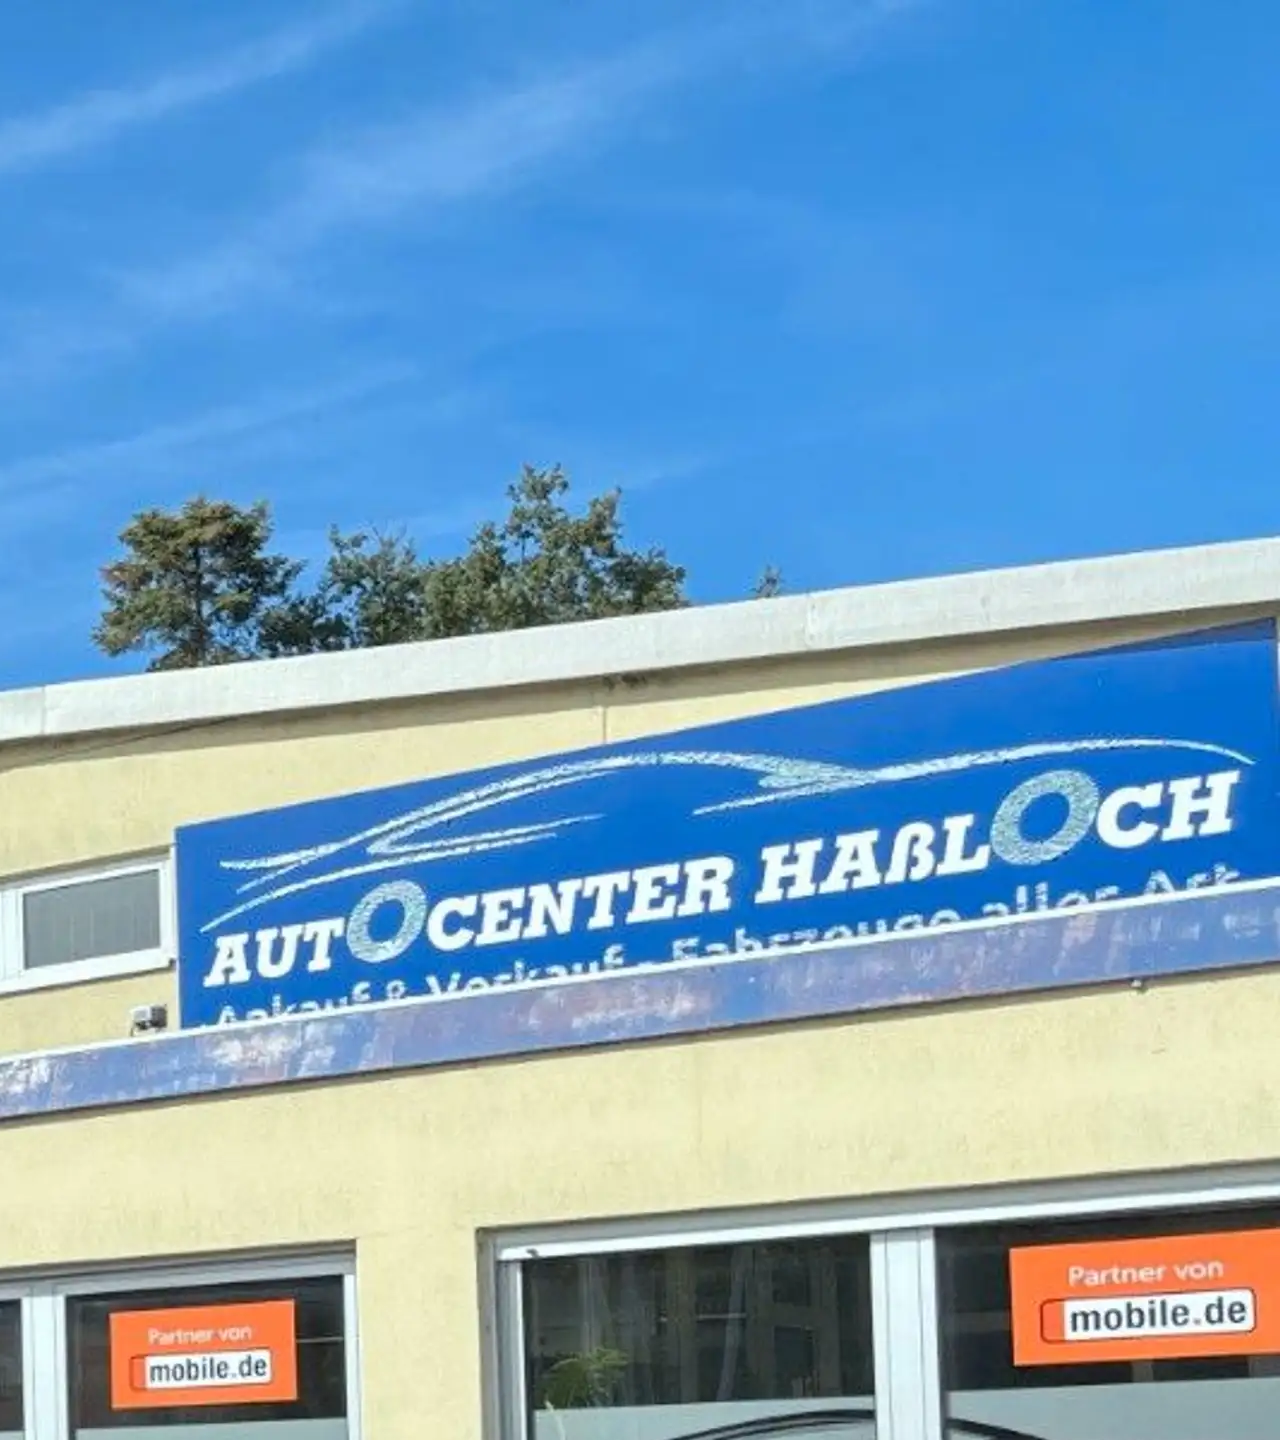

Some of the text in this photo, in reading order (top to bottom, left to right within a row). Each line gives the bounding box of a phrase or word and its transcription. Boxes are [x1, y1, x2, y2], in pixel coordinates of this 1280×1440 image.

[753, 770, 1241, 905] HAßLOCH
[1068, 1260, 1223, 1286] Partner von
[1069, 1296, 1248, 1333] mobile.de
[148, 1324, 253, 1345] Partner von
[149, 1353, 268, 1384] mobile.de
